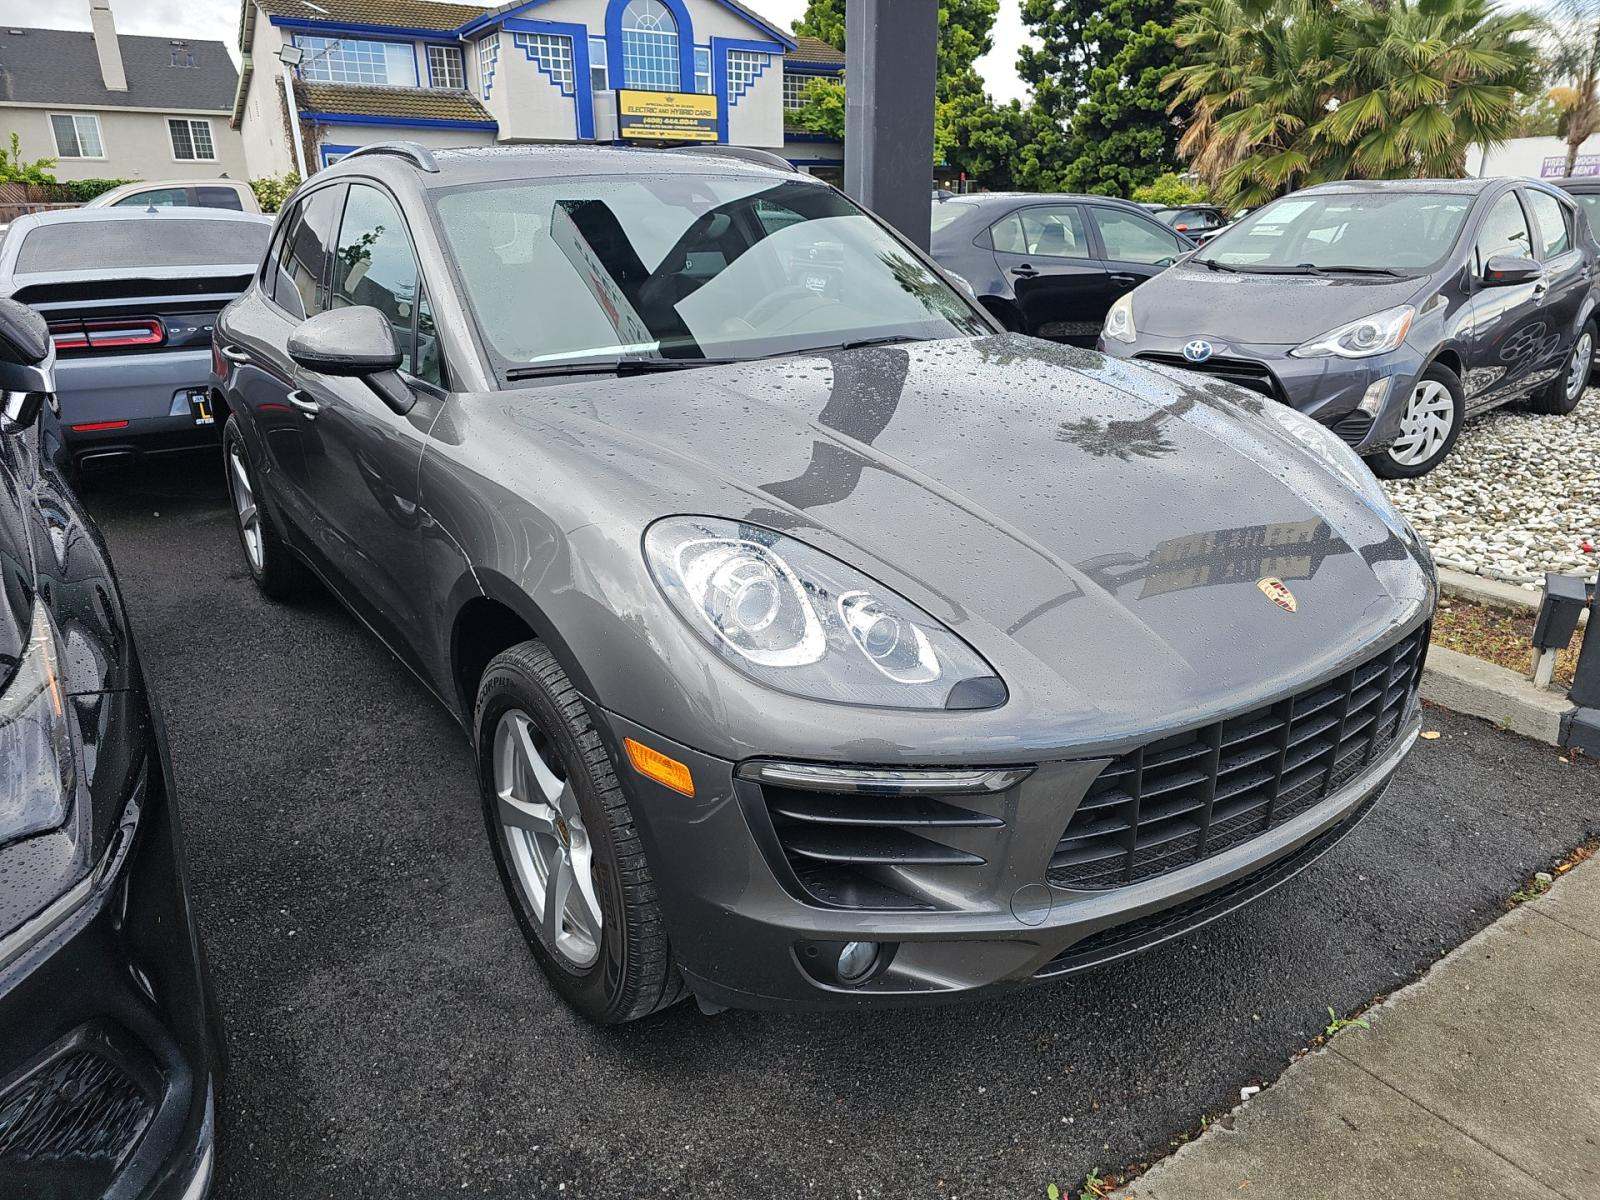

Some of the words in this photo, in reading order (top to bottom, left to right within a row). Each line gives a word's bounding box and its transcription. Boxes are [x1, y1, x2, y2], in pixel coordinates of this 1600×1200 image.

[628, 106, 657, 114] ELECTRIC
[670, 108, 694, 116] HYBRID
[694, 109, 712, 117] CARS
